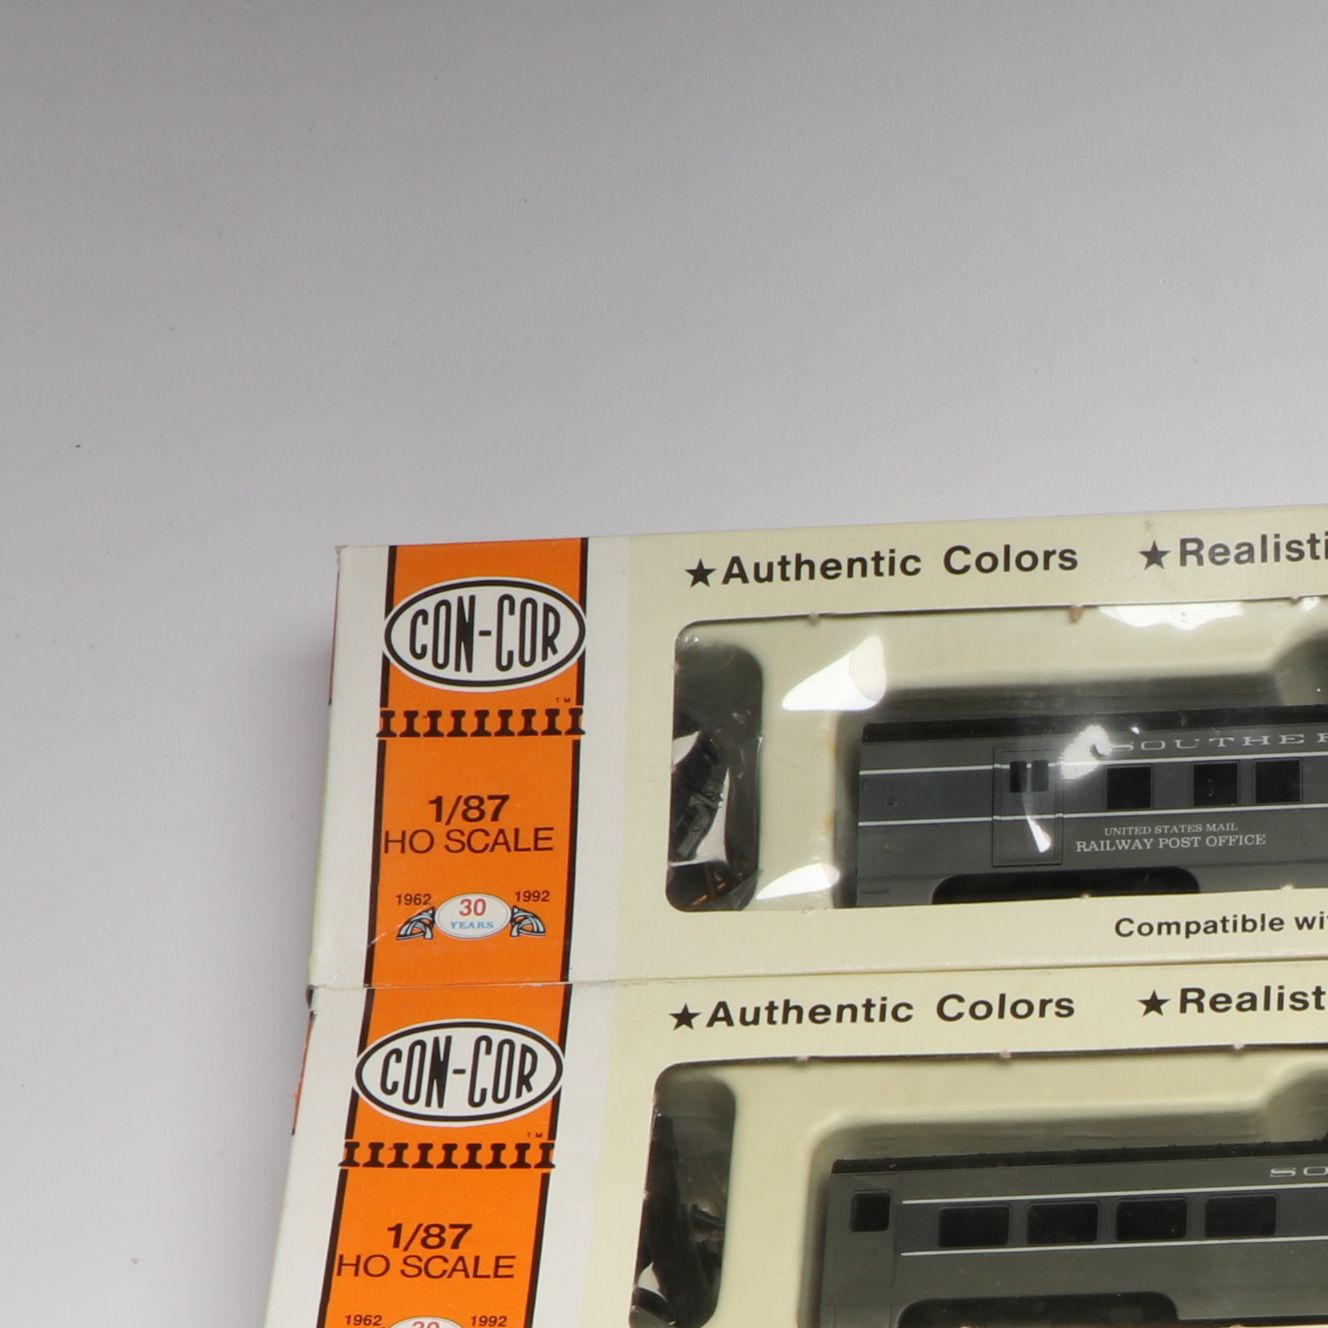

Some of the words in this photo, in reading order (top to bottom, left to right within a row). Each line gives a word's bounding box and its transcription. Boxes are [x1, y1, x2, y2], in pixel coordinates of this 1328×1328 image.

[722, 547, 921, 584] Authentic
[943, 544, 1078, 577] Colors
[409, 594, 560, 673] CON-COR
[427, 795, 510, 823] 1/87
[384, 829, 434, 854] HO
[444, 828, 554, 854] SCALE
[1104, 825, 1150, 837] UNITED
[1155, 823, 1199, 835] STATES
[1204, 822, 1238, 832] MAIL
[1076, 838, 1154, 853] RAILWAY
[1159, 836, 1199, 850] POST
[1205, 833, 1266, 849] OFFICE
[396, 894, 431, 905] 1962
[458, 899, 486, 916] 30
[514, 890, 549, 903] 1992
[450, 920, 494, 930] YEARS
[1115, 912, 1285, 939] Compatible
[706, 997, 914, 1028] Authentic
[936, 993, 1075, 1021] Colors
[380, 1035, 538, 1109] CON-COR
[387, 1223, 472, 1249] 1/87
[336, 1255, 391, 1278] HO
[400, 1255, 516, 1279] SCALE
[344, 1315, 382, 1326] 1962
[470, 1315, 507, 1327] 1992
